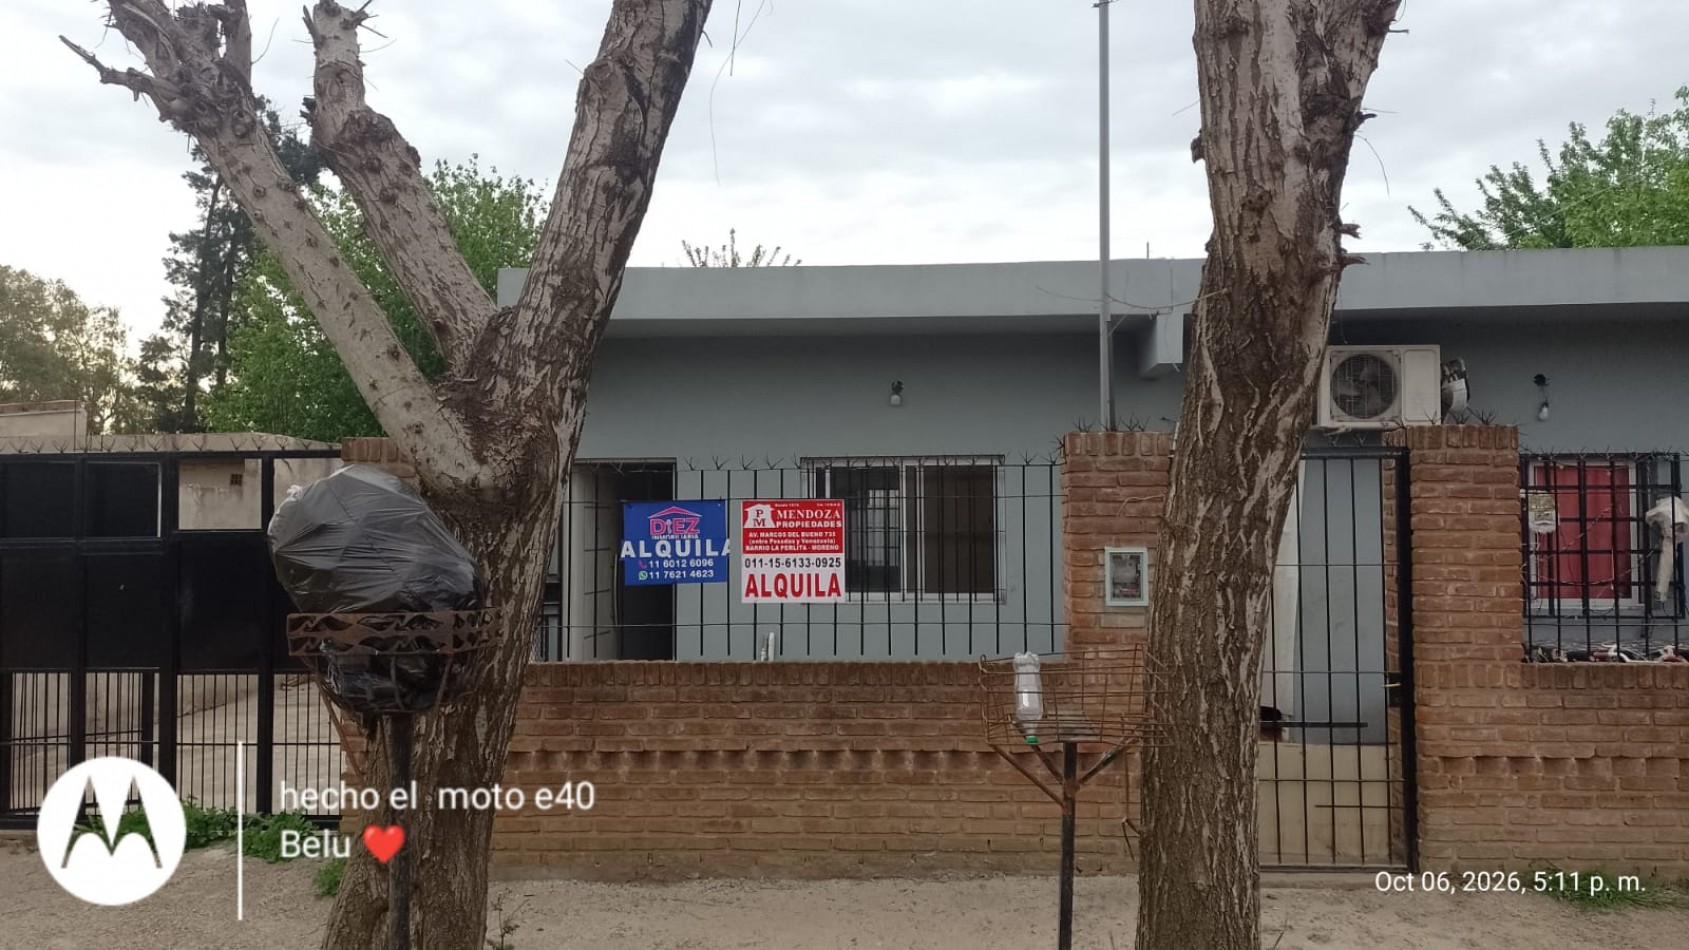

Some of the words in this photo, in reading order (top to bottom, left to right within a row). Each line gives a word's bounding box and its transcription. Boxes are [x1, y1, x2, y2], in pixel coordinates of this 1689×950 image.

[776, 509, 841, 519] MENDOZA
[776, 520, 842, 528] PROPIEDADES
[649, 560, 660, 569] 11
[663, 559, 687, 568] 6012
[689, 558, 714, 568] 6096
[744, 557, 842, 568] 011-15-6133-0925
[649, 571, 660, 579] 11
[663, 570, 687, 579] 7621
[689, 569, 714, 578] 4623
[744, 572, 842, 599] ALQUILA
